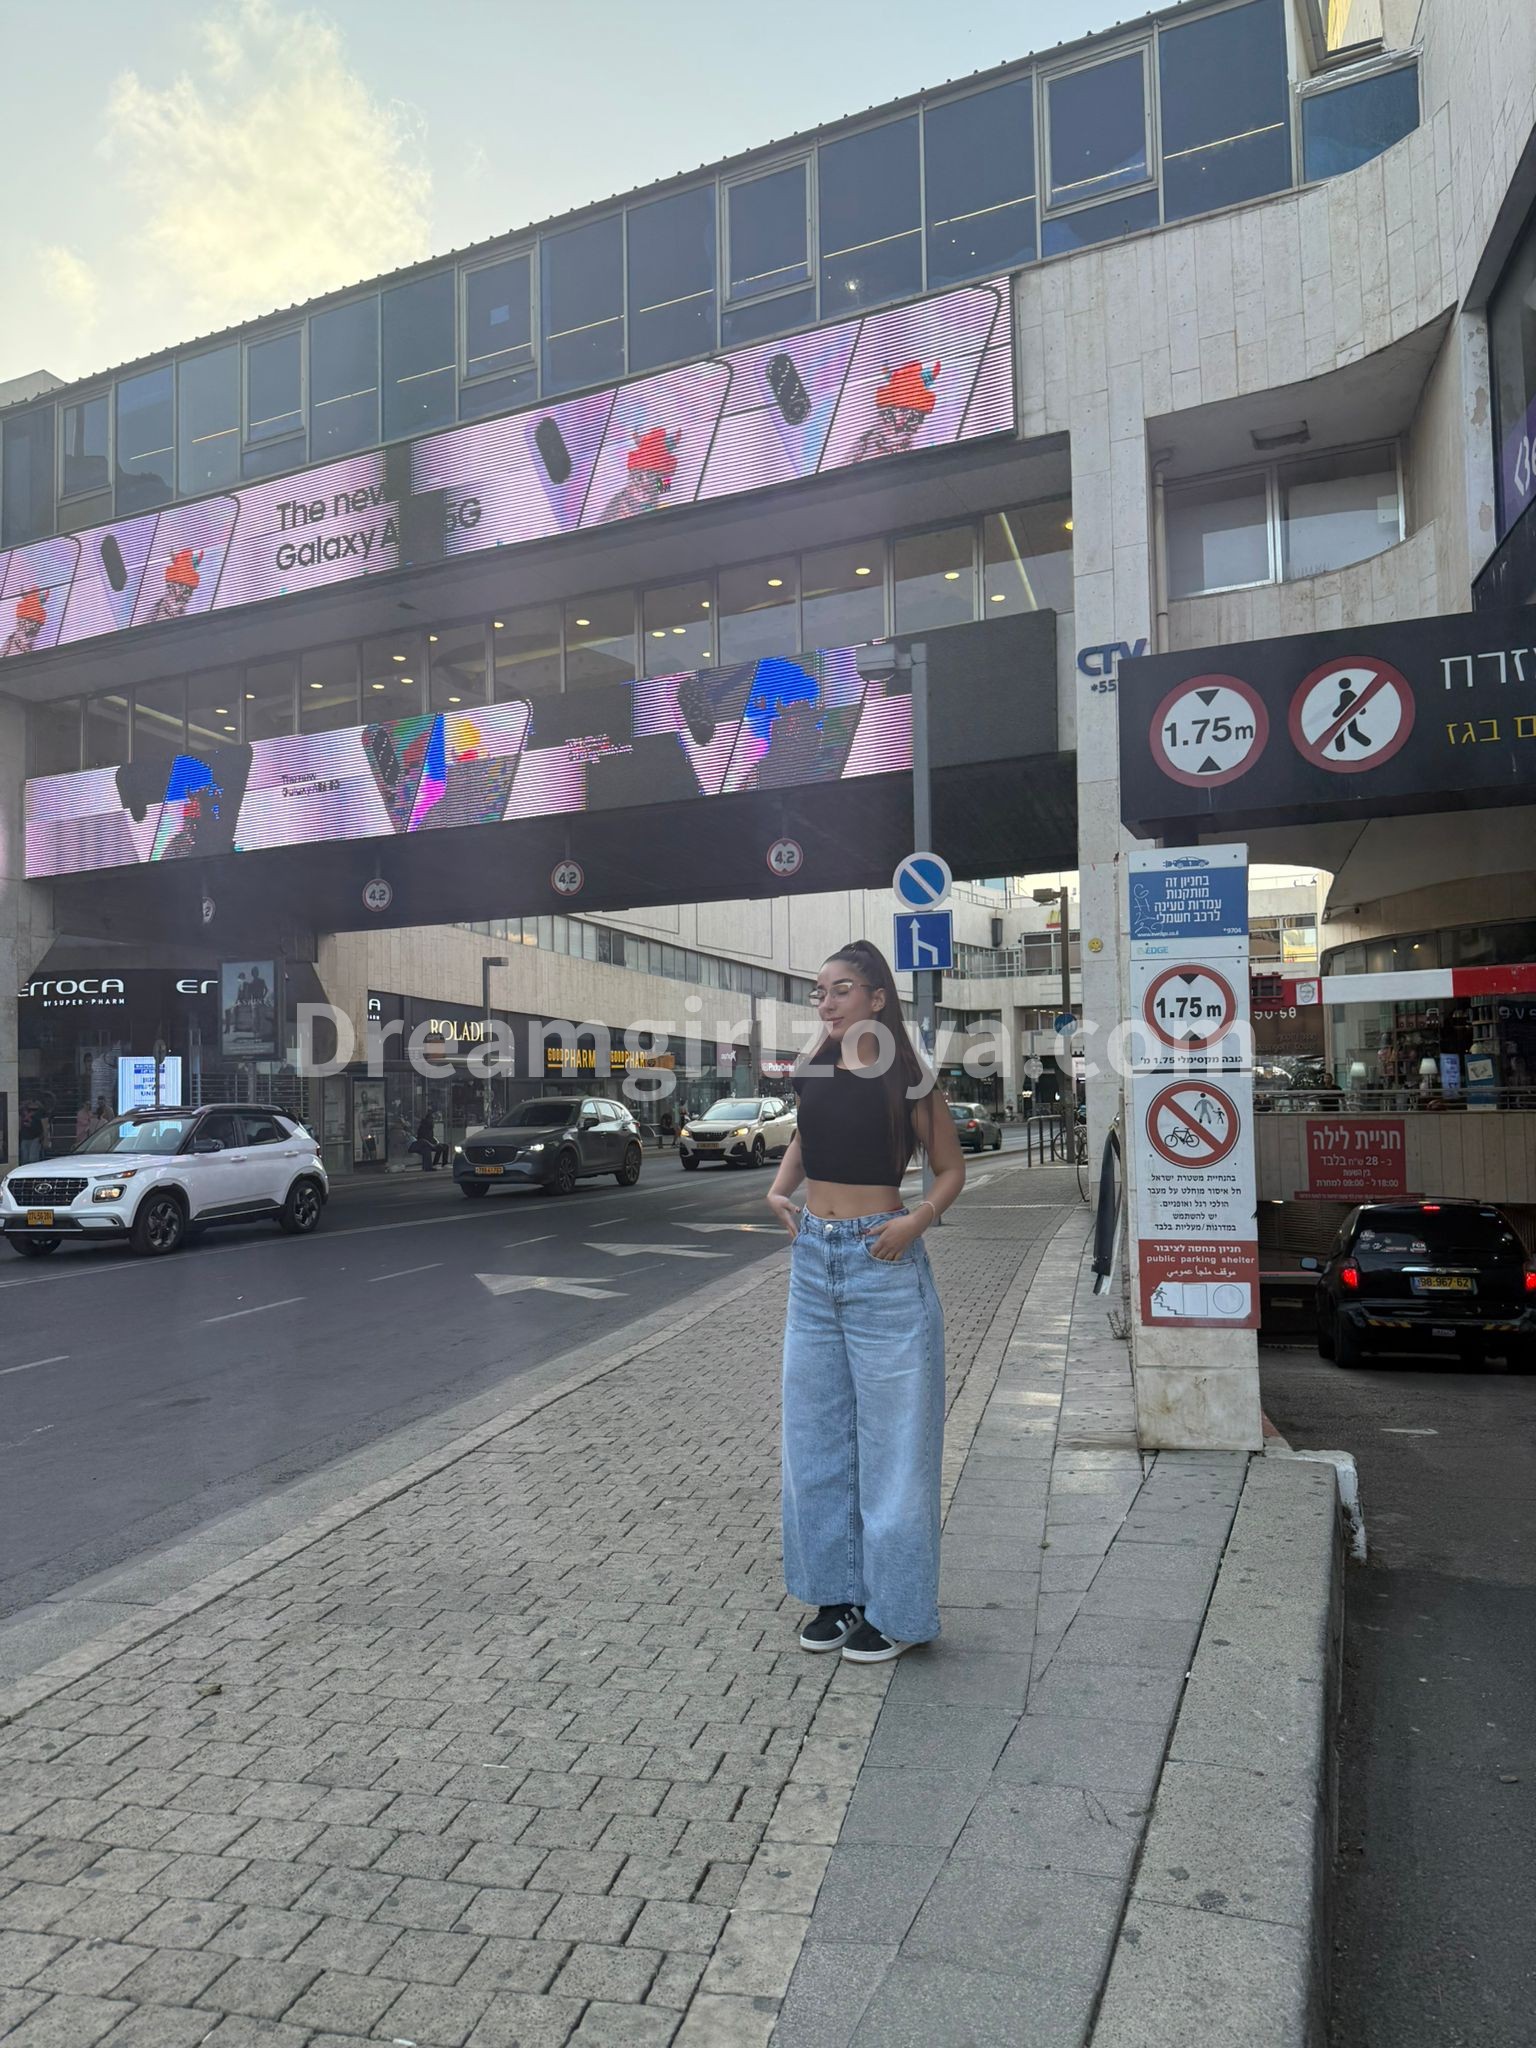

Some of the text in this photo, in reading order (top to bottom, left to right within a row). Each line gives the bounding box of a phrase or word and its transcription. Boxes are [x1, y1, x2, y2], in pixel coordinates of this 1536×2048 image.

[276, 500, 326, 531] The
[276, 529, 375, 570] Galaxy
[1440, 648, 1536, 690] זרח
[1446, 719, 1501, 745] בגז
[1165, 875, 1210, 888] בחניון זה
[1166, 887, 1209, 900] מותקנות
[1154, 899, 1222, 912] עמדות טעינה
[1156, 909, 1221, 924] לרכב חשמלי
[563, 1048, 596, 1069] PHARM
[1154, 1056, 1175, 1064] 1.75
[1177, 1055, 1220, 1065] מקסימלי
[1313, 1125, 1401, 1150] חניית לילה
[1320, 1154, 1347, 1166] בלבד
[1365, 1156, 1378, 1166] 28
[1151, 1173, 1236, 1182] בהנחיית משטרת ישראל
[1316, 1178, 1342, 1187] למחרת
[1378, 1179, 1399, 1187] 18:00
[1147, 1186, 1242, 1195] חל איסור מוחלט על מעבר
[1194, 1200, 1207, 1208] רגל
[1209, 1200, 1229, 1208] הולכי
[1172, 1212, 1218, 1220] יש להשתמש
[1154, 1222, 1173, 1231] בלבד
[1153, 1243, 1242, 1254] חניון מחסה לציבור
[1146, 1255, 1255, 1265] public parking shelter
[1166, 1264, 1237, 1278] موقف ملجأ عمومي
